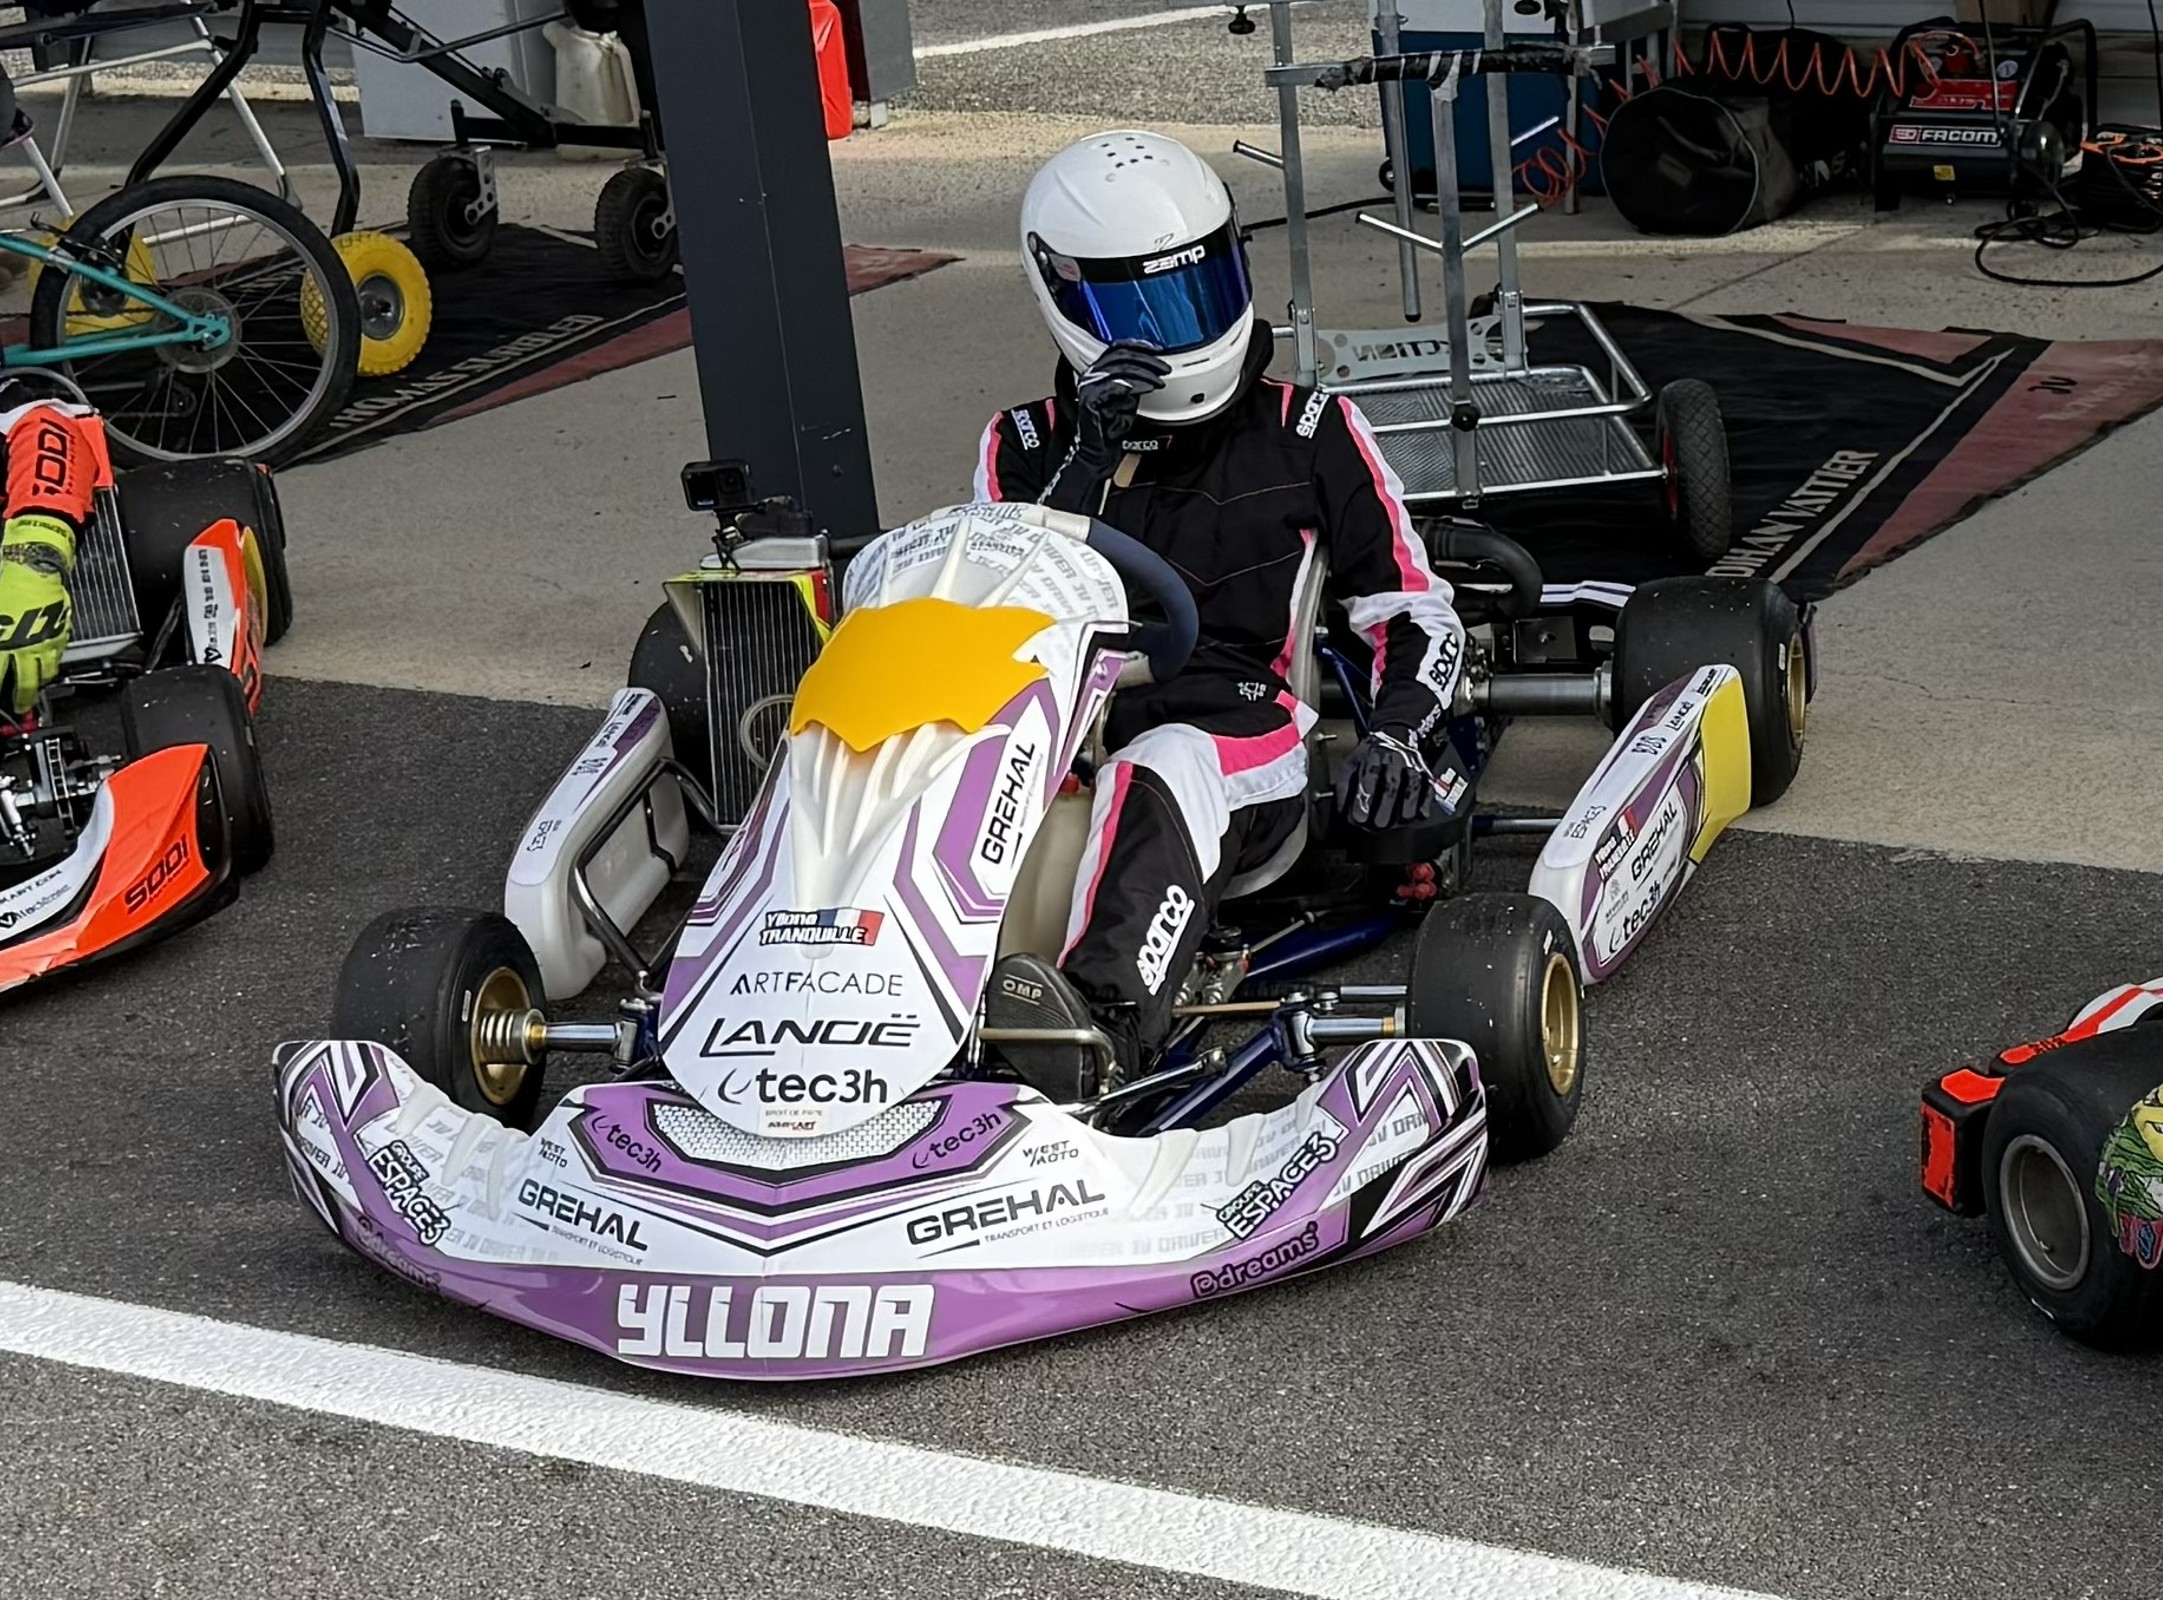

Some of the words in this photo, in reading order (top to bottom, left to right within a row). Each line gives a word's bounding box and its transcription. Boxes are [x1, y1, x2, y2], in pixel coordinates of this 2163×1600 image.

[1922, 128, 1998, 143] FACOM
[1143, 245, 1206, 274] zamp
[1767, 450, 1880, 517] VATTIER
[980, 743, 1036, 865] GREHAL
[124, 833, 189, 916] SODI
[1631, 801, 1678, 881] GREHAL
[759, 926, 868, 946] TRANQUILLE
[1136, 884, 1196, 996] sparco
[1002, 979, 1042, 999] OMP
[755, 1067, 889, 1104] tec3h
[605, 1123, 662, 1173] tec3h
[927, 1111, 1002, 1159] tec3h
[519, 1178, 649, 1252] GREHAL
[906, 1178, 1107, 1246] GREHAL
[617, 1283, 935, 1359] YLLONA
